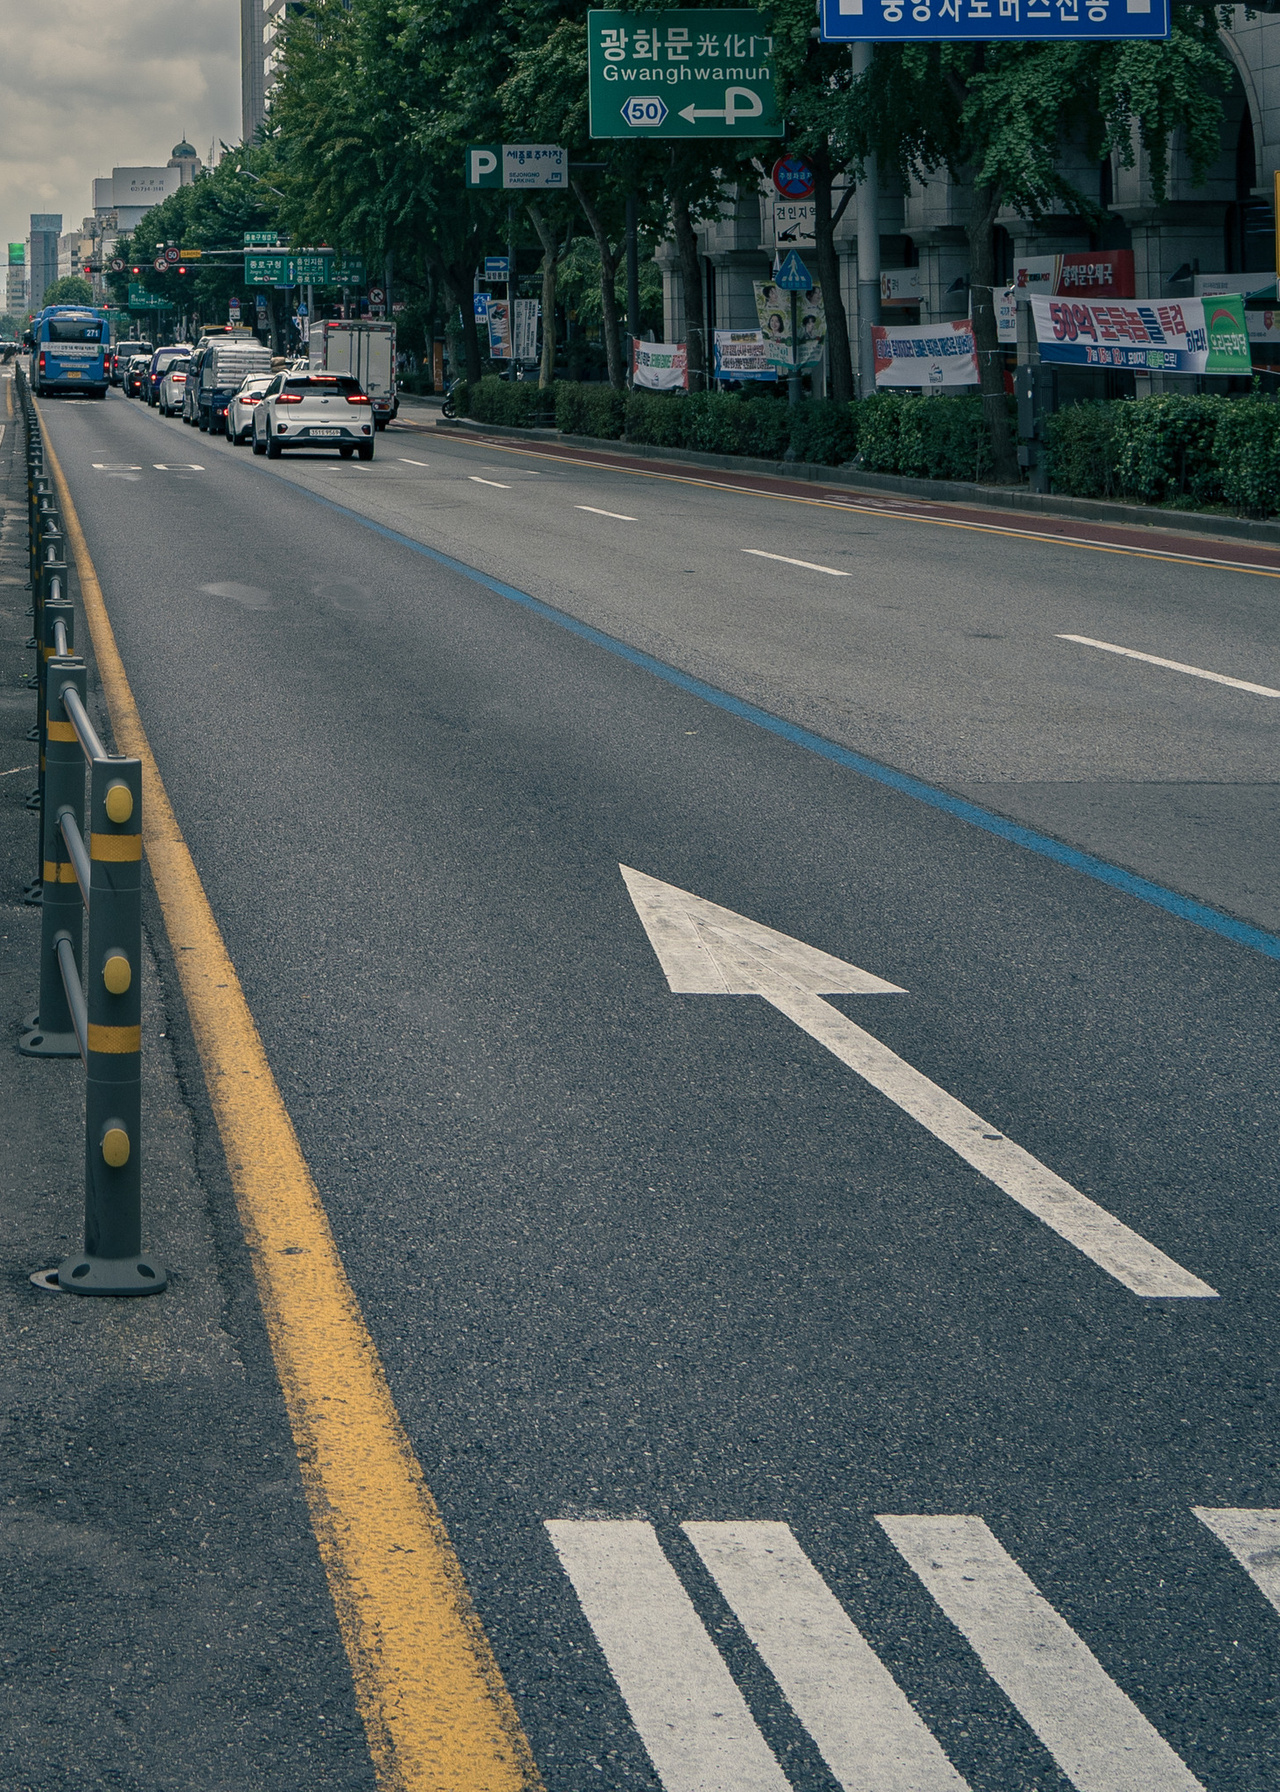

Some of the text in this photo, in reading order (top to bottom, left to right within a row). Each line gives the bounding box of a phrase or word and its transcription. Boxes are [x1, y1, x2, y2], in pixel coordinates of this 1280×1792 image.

[600, 28, 693, 61] 광화문
[603, 65, 770, 84] Gwanghwamun
[631, 103, 659, 120] 50
[471, 150, 497, 184] P
[168, 251, 177, 259] 50
[249, 260, 282, 269] 종로구청
[1063, 264, 1112, 286] 광화문우체국
[86, 329, 99, 337] 271
[1049, 303, 1098, 342] 50억
[1090, 306, 1168, 344] 도둑놈들
[1157, 304, 1187, 335] 특검
[1210, 333, 1248, 356] 우리공화당
